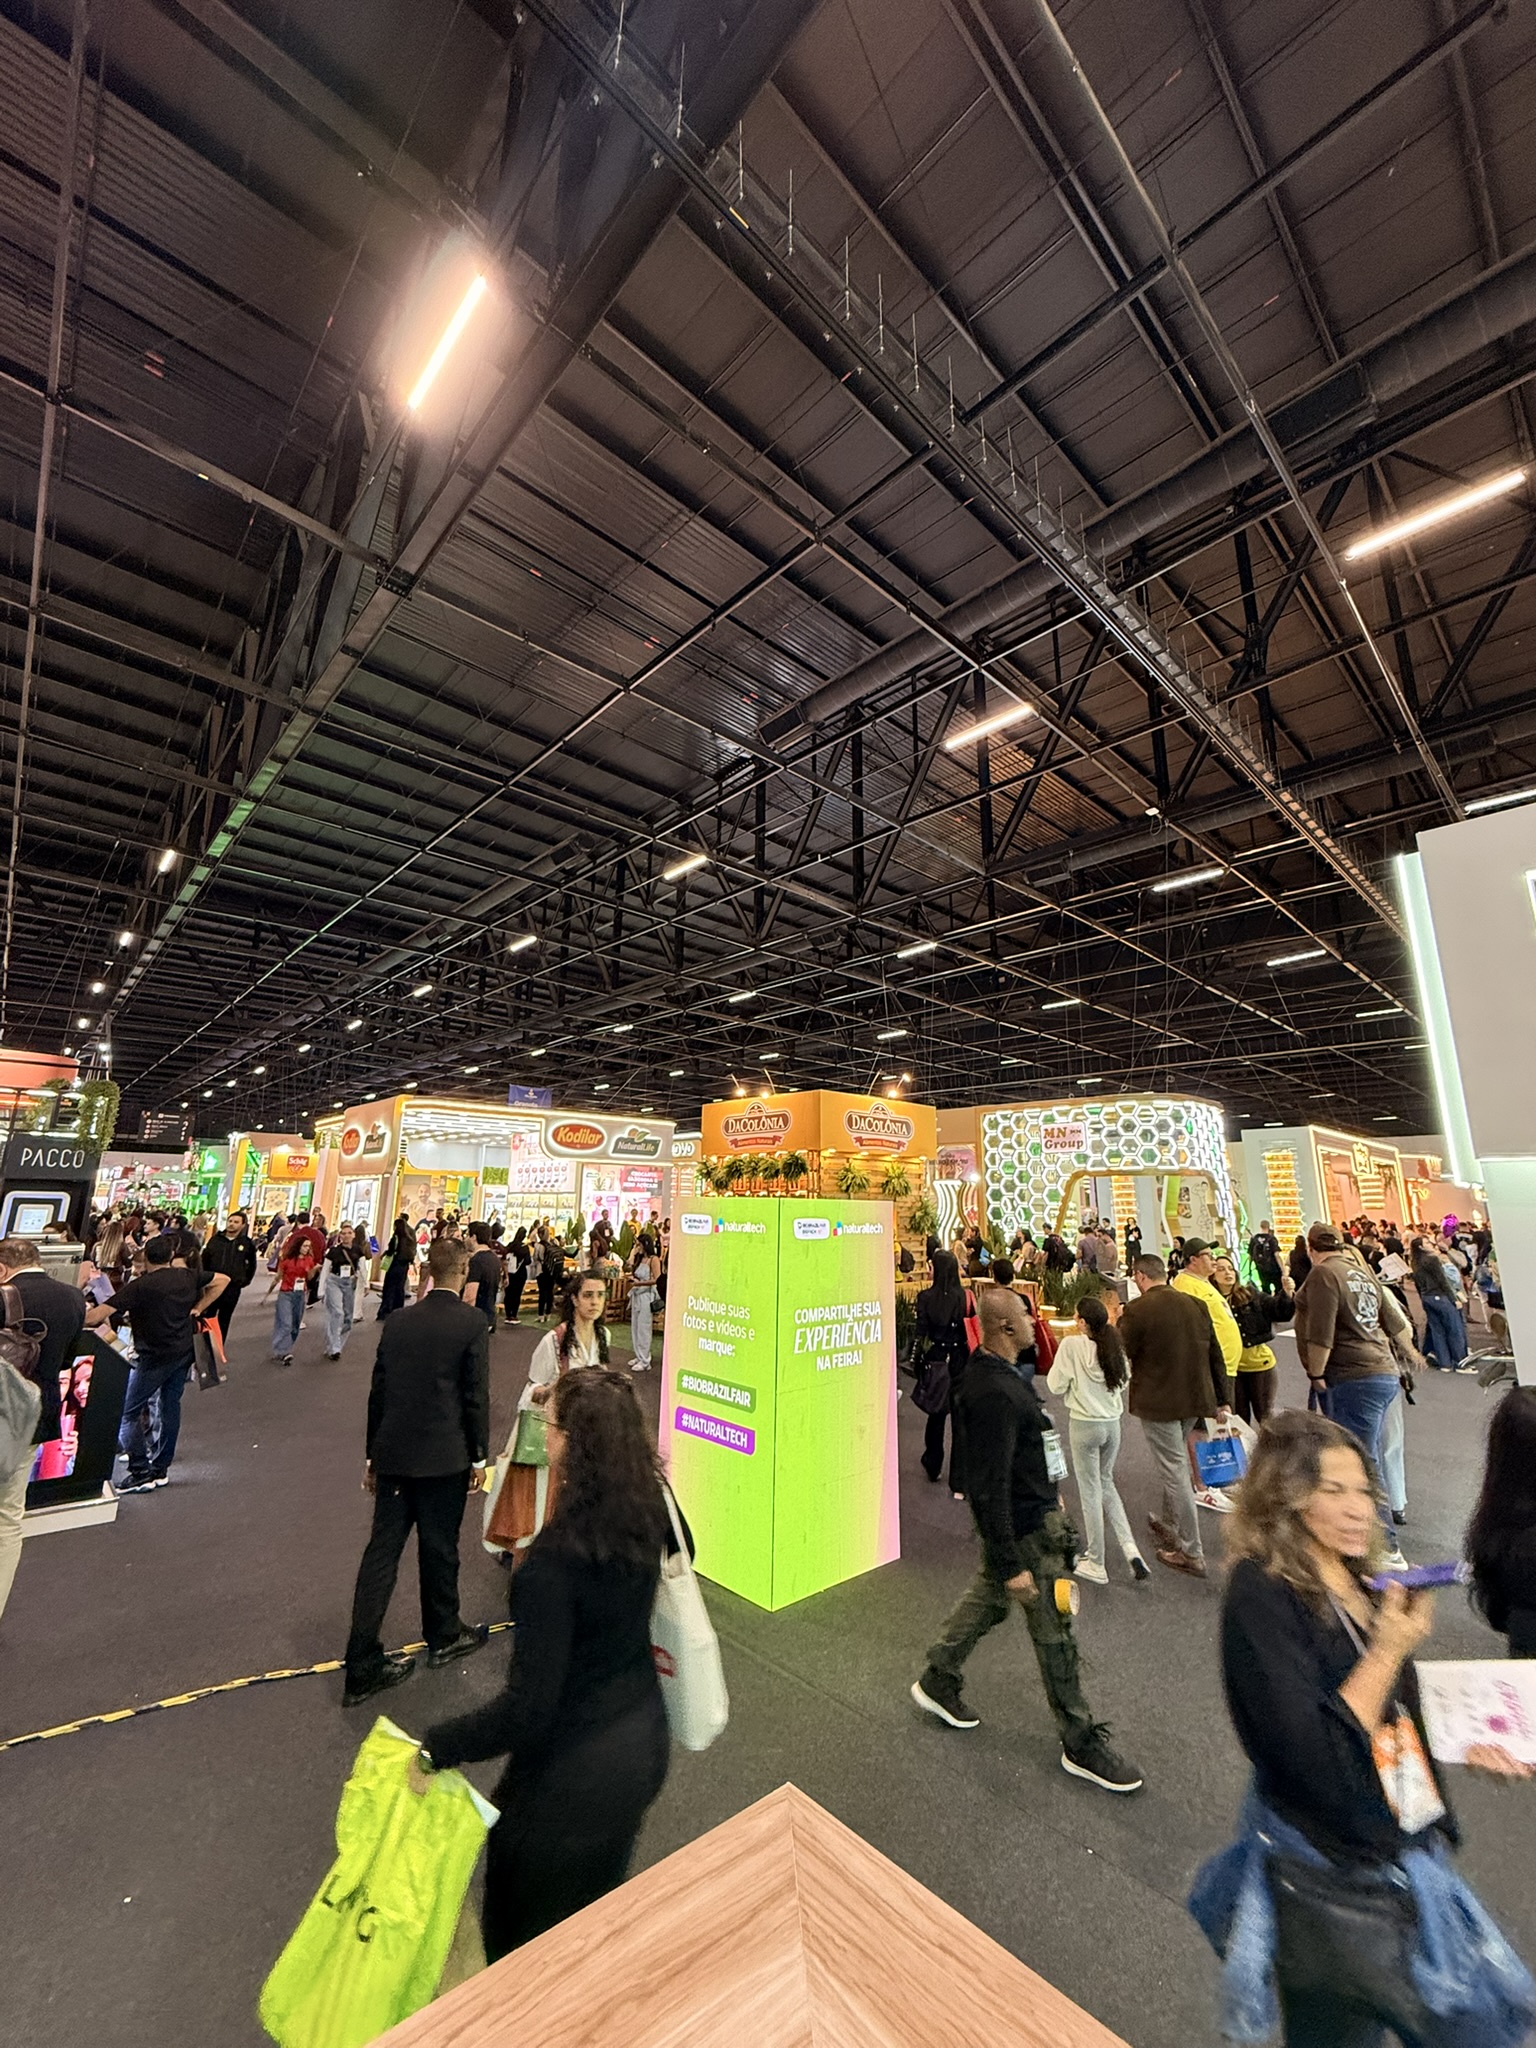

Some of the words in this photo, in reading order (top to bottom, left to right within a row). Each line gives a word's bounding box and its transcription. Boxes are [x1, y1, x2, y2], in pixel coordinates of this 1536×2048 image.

[556, 1126, 603, 1145] Kodilar
[1043, 1126, 1067, 1139] MN
[1044, 1139, 1084, 1150] Group
[20, 1147, 85, 1168] PACCO
[725, 1221, 766, 1234] naturaltech
[843, 1222, 884, 1235] naturaltech
[688, 1295, 727, 1316] Publique
[728, 1304, 751, 1320] suas
[794, 1302, 862, 1324] COMPARTILHE
[863, 1301, 881, 1316] SUA
[682, 1312, 707, 1331] fotos
[708, 1319, 715, 1333] e
[715, 1319, 747, 1340] vídeos
[748, 1328, 755, 1341] e
[794, 1317, 882, 1354] EXPERIÊNCIA
[698, 1337, 736, 1357] marque:
[816, 1354, 831, 1371] NA
[832, 1349, 862, 1368] FEIRA!
[681, 1374, 751, 1408] #BIOBRAZILFAIR
[681, 1412, 748, 1448] #NATURALTECH
